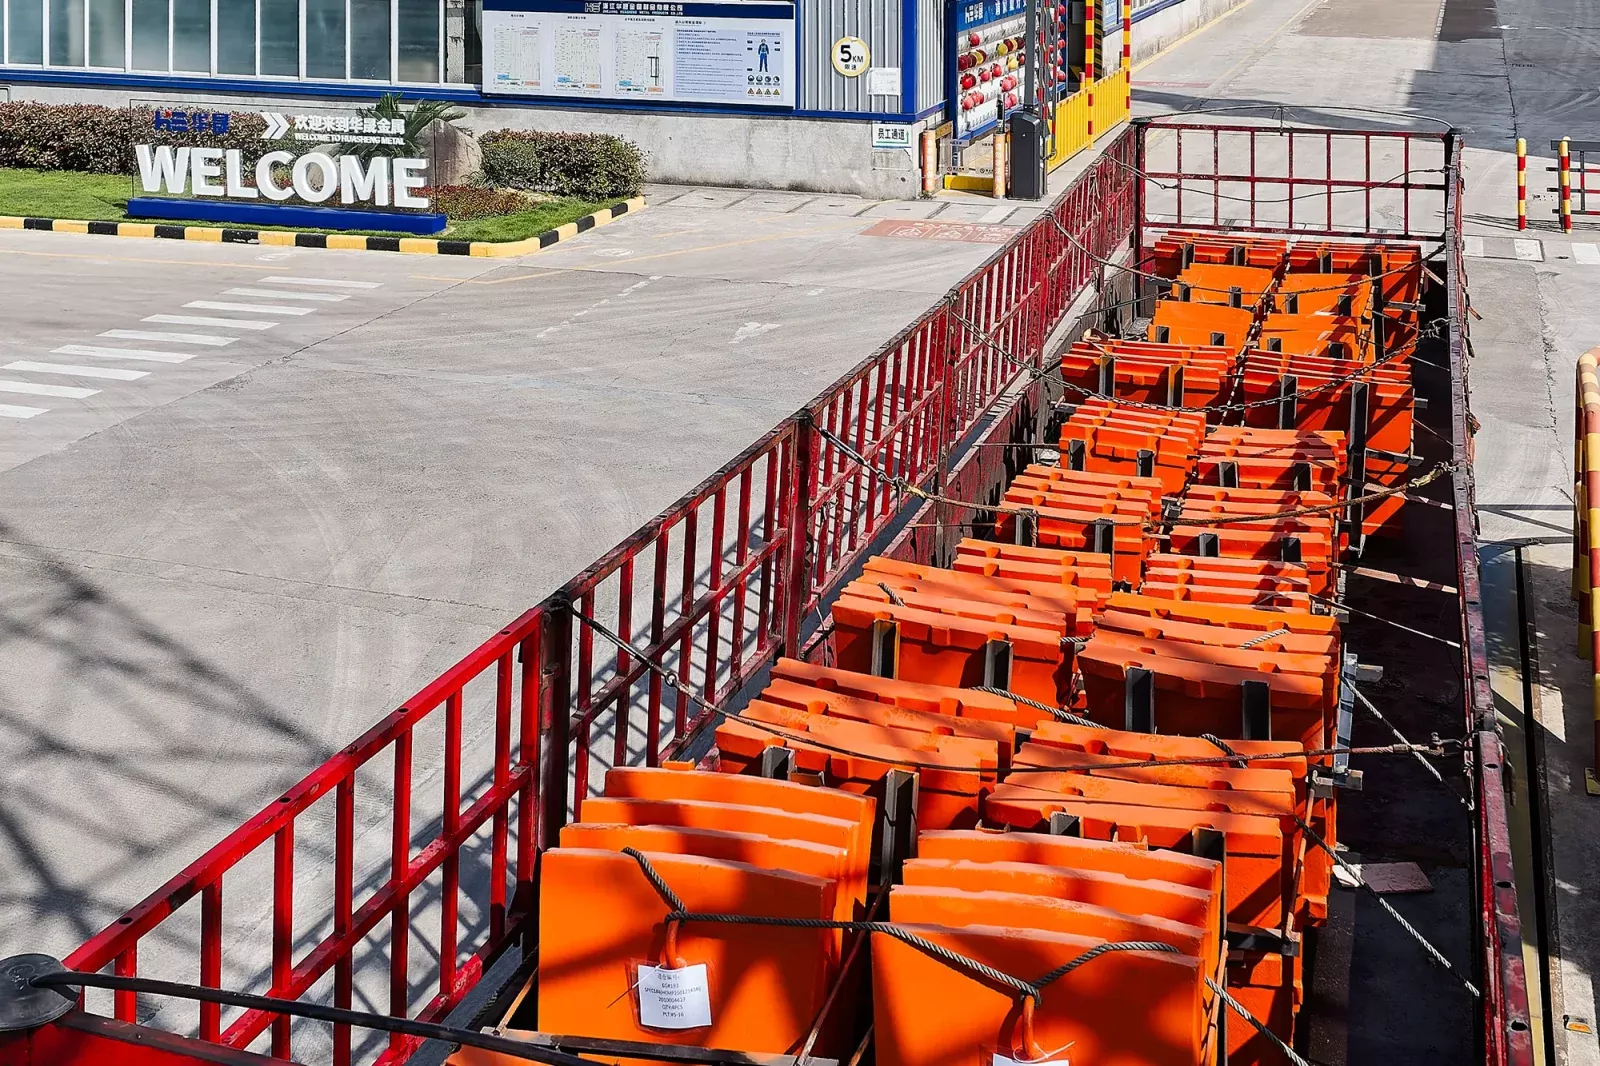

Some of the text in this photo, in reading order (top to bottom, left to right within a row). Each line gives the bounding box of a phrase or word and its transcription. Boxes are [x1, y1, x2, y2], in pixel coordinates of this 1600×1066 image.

[840, 45, 851, 63] 5
[294, 115, 405, 135] 欢迎来到华晟金属
[878, 128, 905, 140] 员工通道
[341, 135, 380, 144] HUASHENG
[381, 137, 406, 145] METAL
[135, 144, 430, 208] WELCOME
